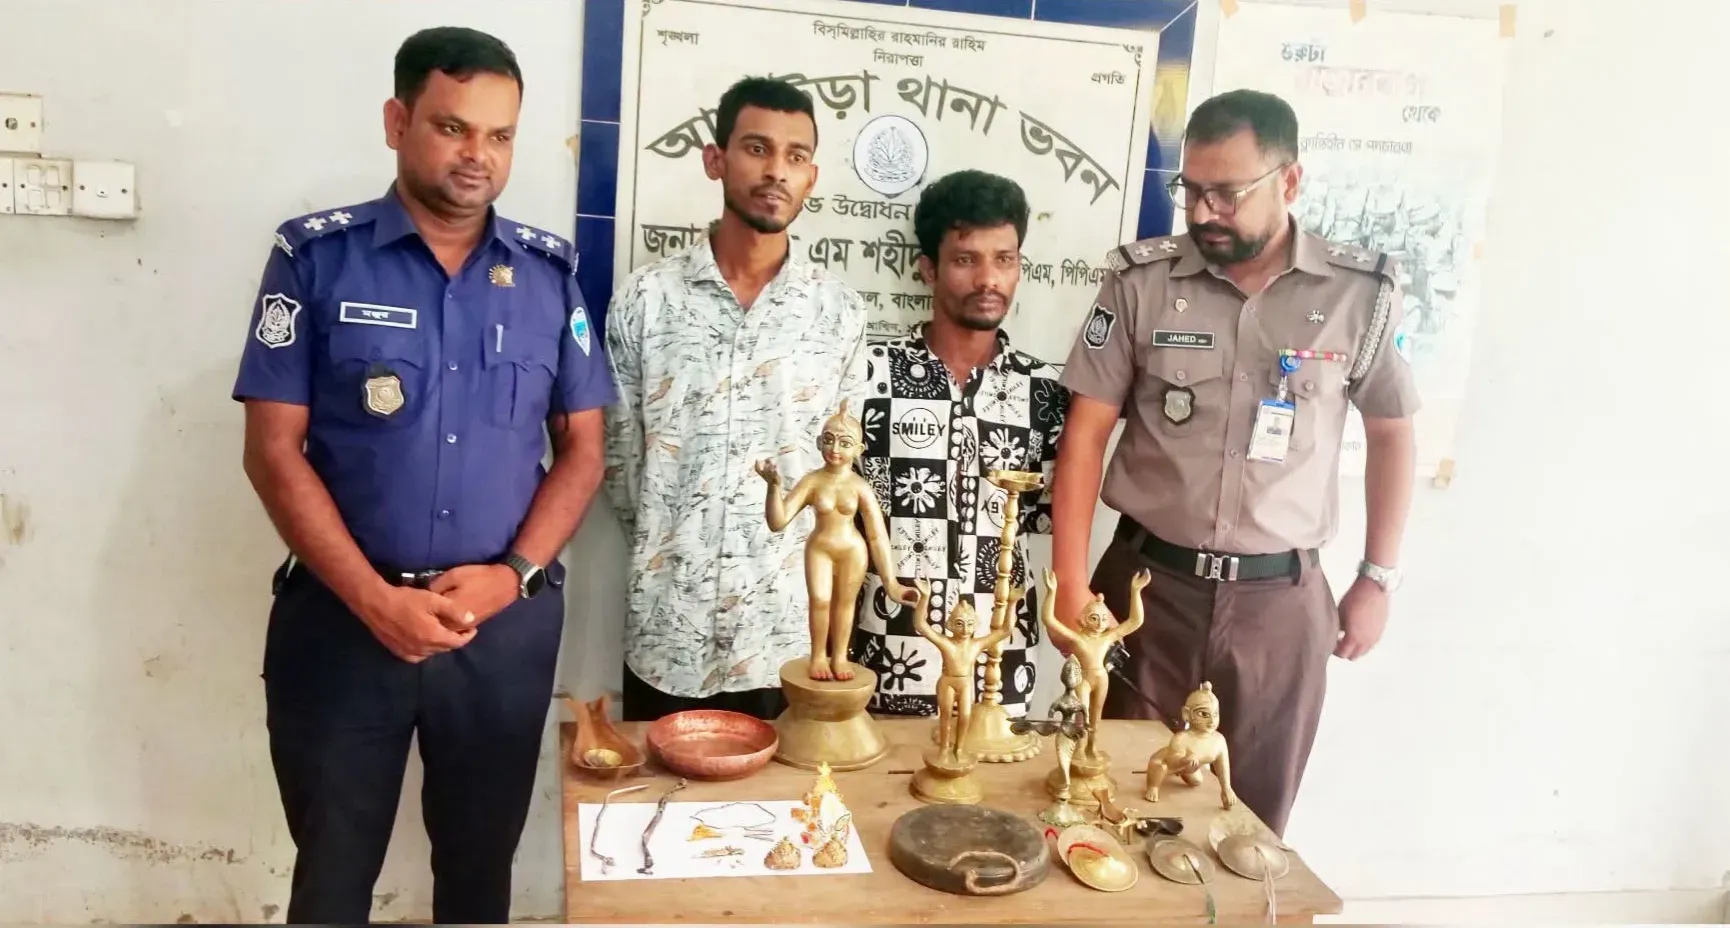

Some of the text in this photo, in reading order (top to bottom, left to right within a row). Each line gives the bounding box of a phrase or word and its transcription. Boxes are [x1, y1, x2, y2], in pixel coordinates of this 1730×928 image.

[890, 31, 947, 49] রাহমানির
[951, 35, 987, 52] রাহিম
[873, 48, 925, 67] নিরাপত্তা
[1090, 71, 1126, 85] প্রগতি
[896, 73, 1008, 136] থানা
[1018, 110, 1120, 206] ভবন
[831, 194, 913, 221] উদ্বোধন
[641, 222, 703, 258] জনা
[808, 237, 854, 272] এম
[1167, 334, 1197, 343] JAHED
[892, 421, 947, 437] SMILEY
